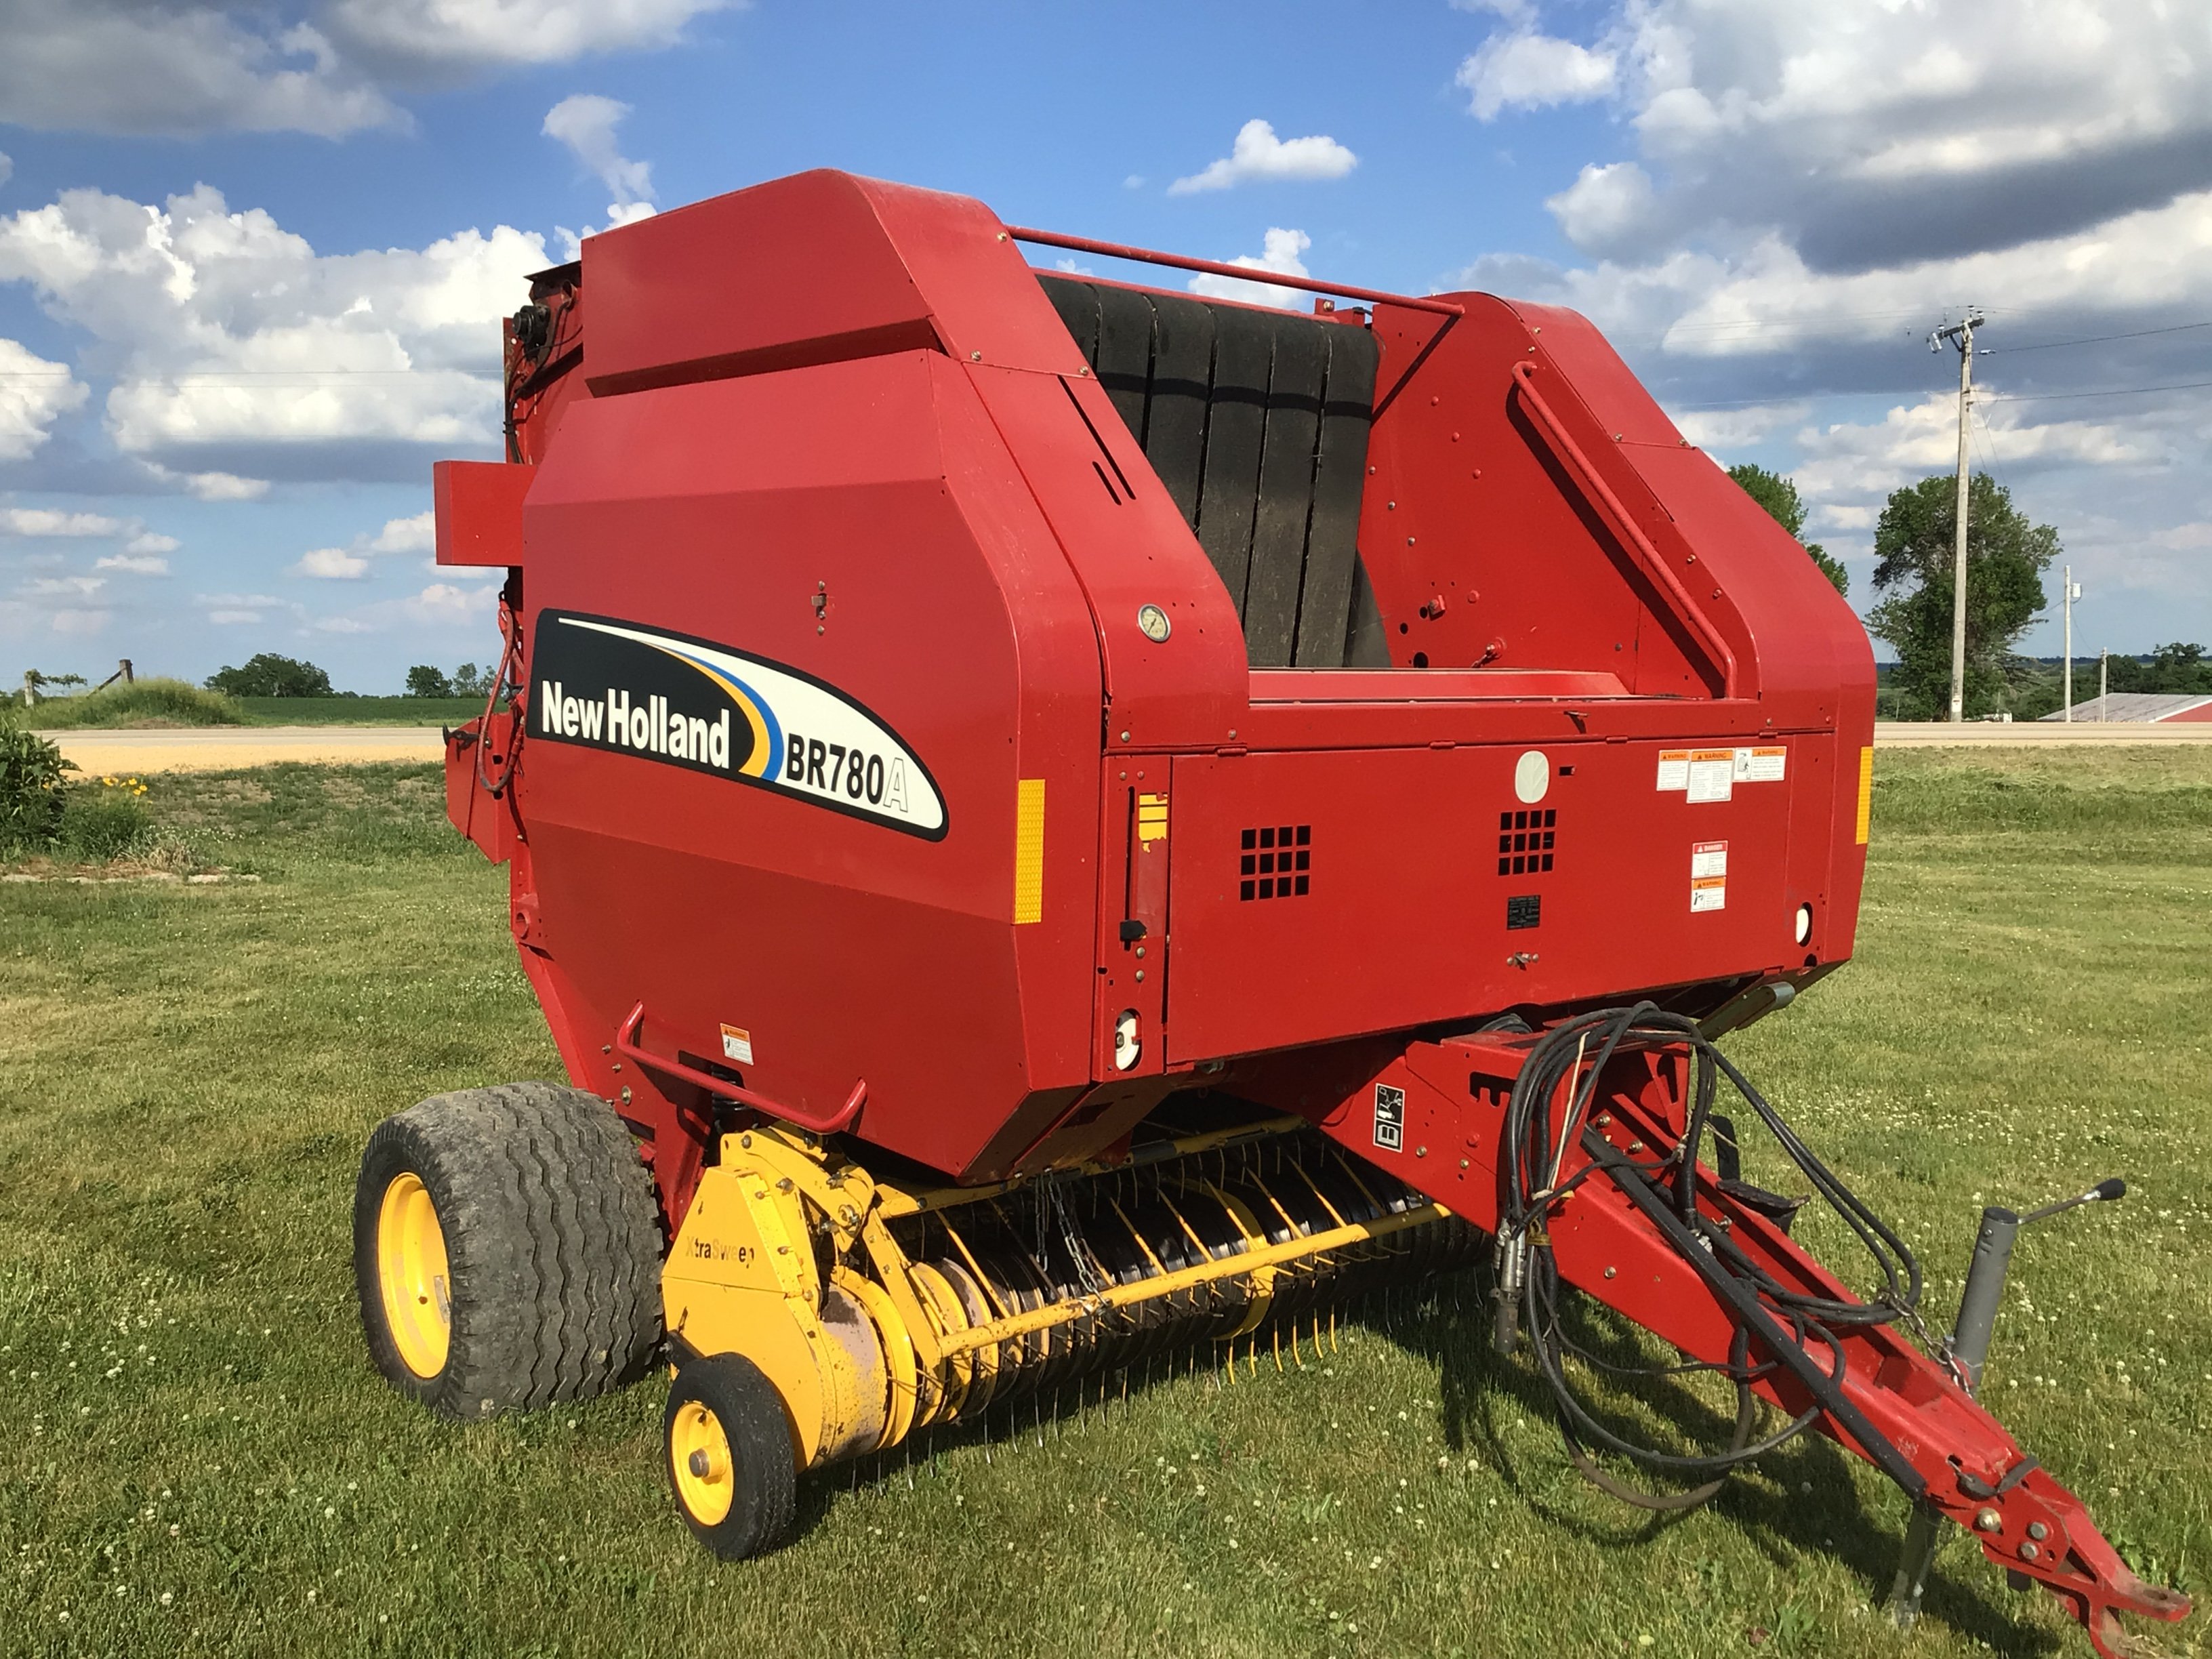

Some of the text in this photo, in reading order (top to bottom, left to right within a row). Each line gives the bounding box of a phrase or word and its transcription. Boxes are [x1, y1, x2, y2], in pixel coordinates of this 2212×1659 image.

[542, 680, 730, 769] New Holland
[786, 733, 908, 813] BR780A
